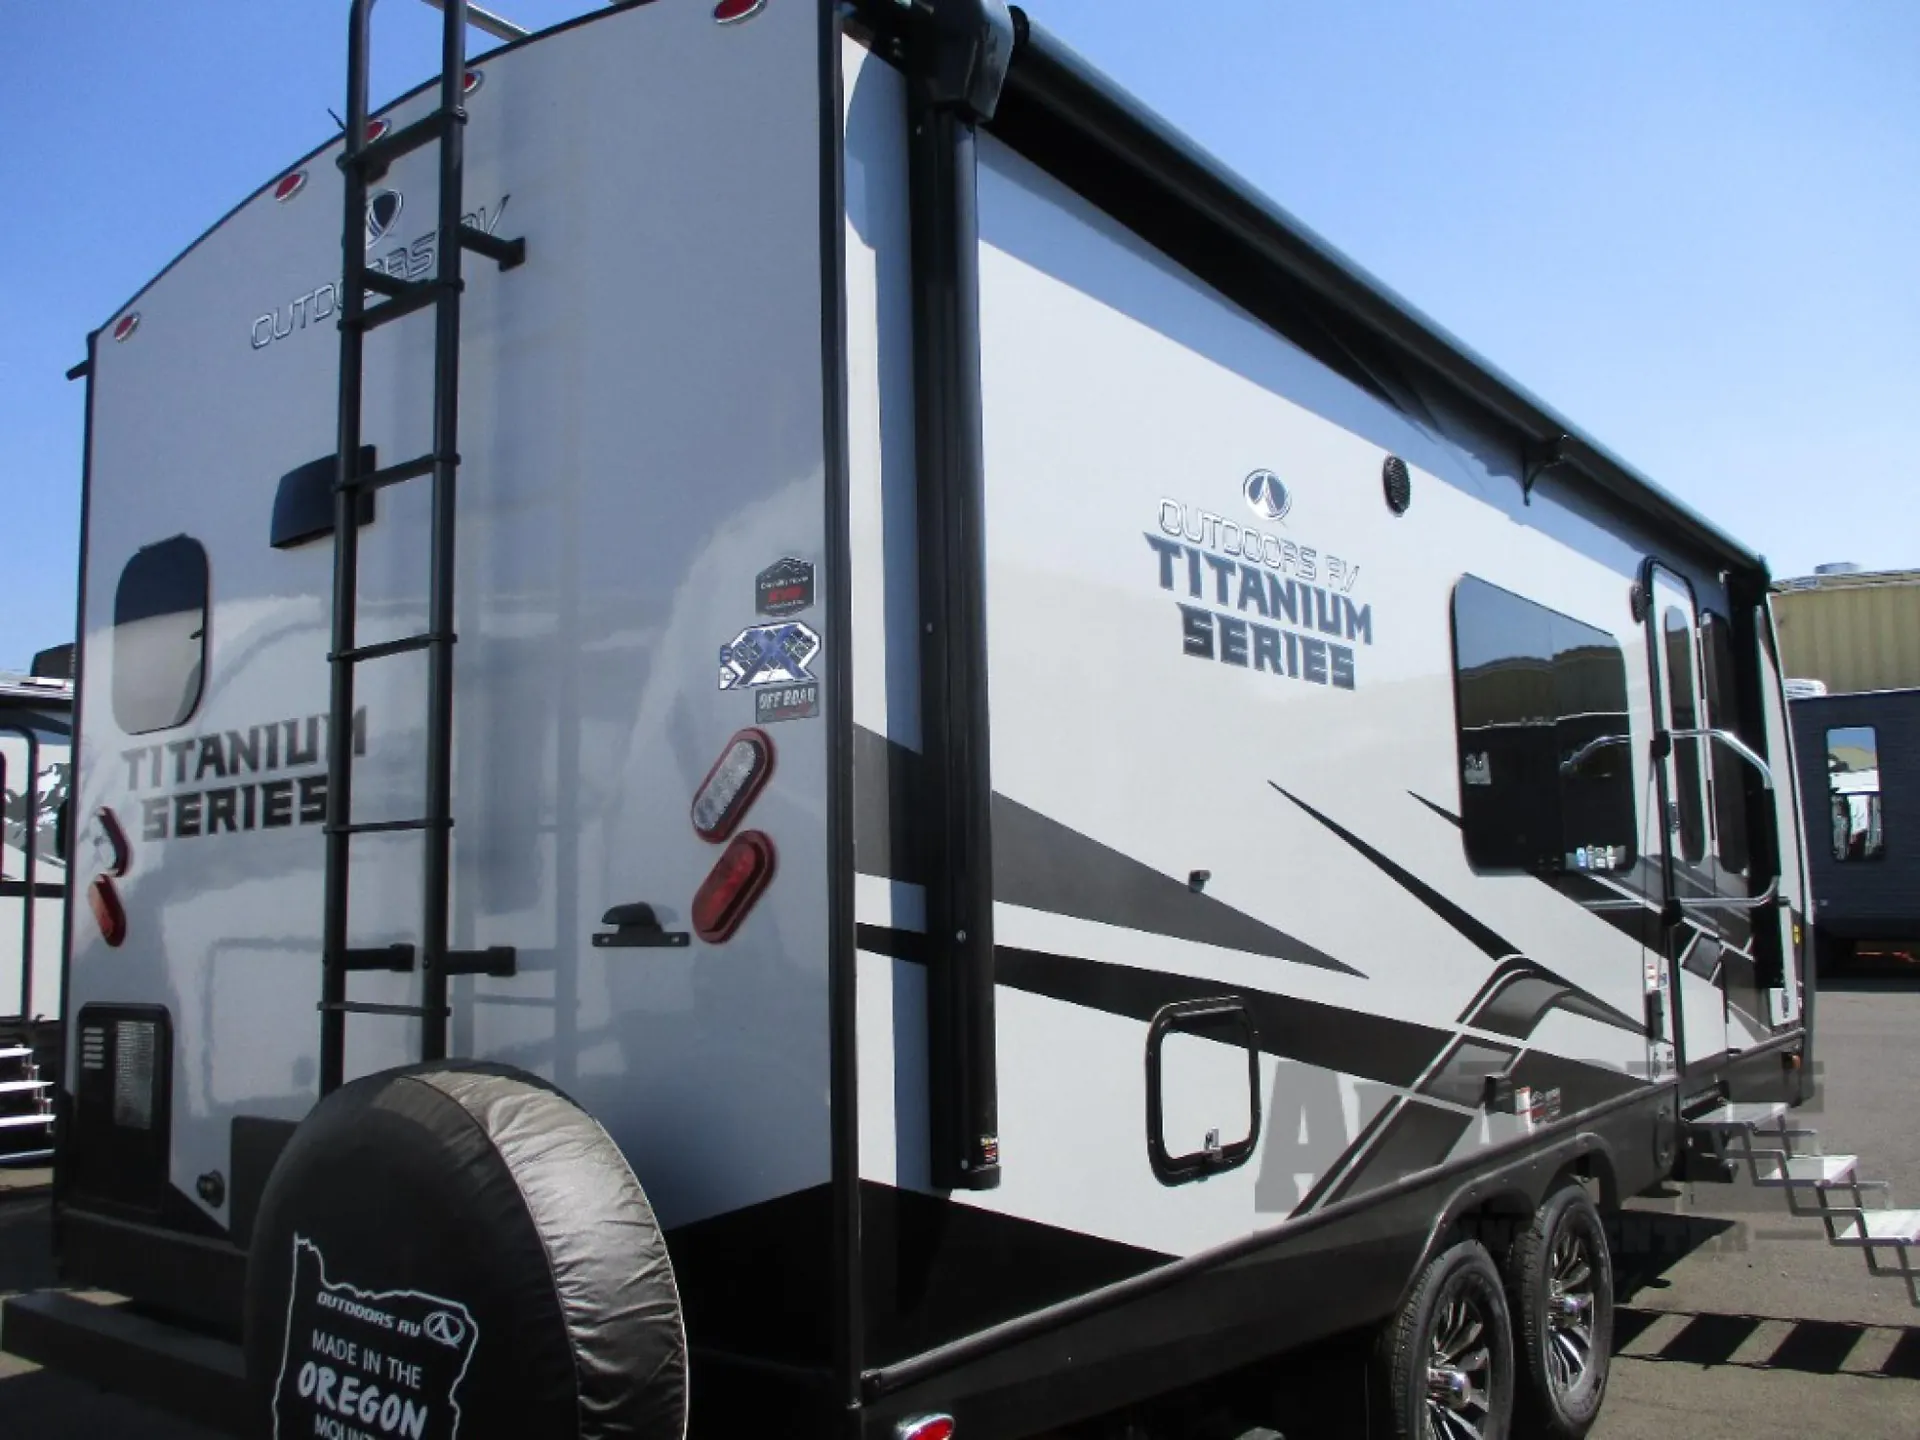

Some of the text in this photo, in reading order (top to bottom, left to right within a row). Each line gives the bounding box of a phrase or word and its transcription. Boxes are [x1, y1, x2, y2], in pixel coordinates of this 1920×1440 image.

[1159, 498, 1361, 593] OUTDOORS RV
[1142, 531, 1373, 646] TITANIUM
[1175, 601, 1355, 690] SERIES
[141, 772, 330, 842] SERIES
[315, 1290, 422, 1338] OUTDOORS RV
[311, 1329, 423, 1389] MADE IN THE
[297, 1361, 428, 1440] OREGON
